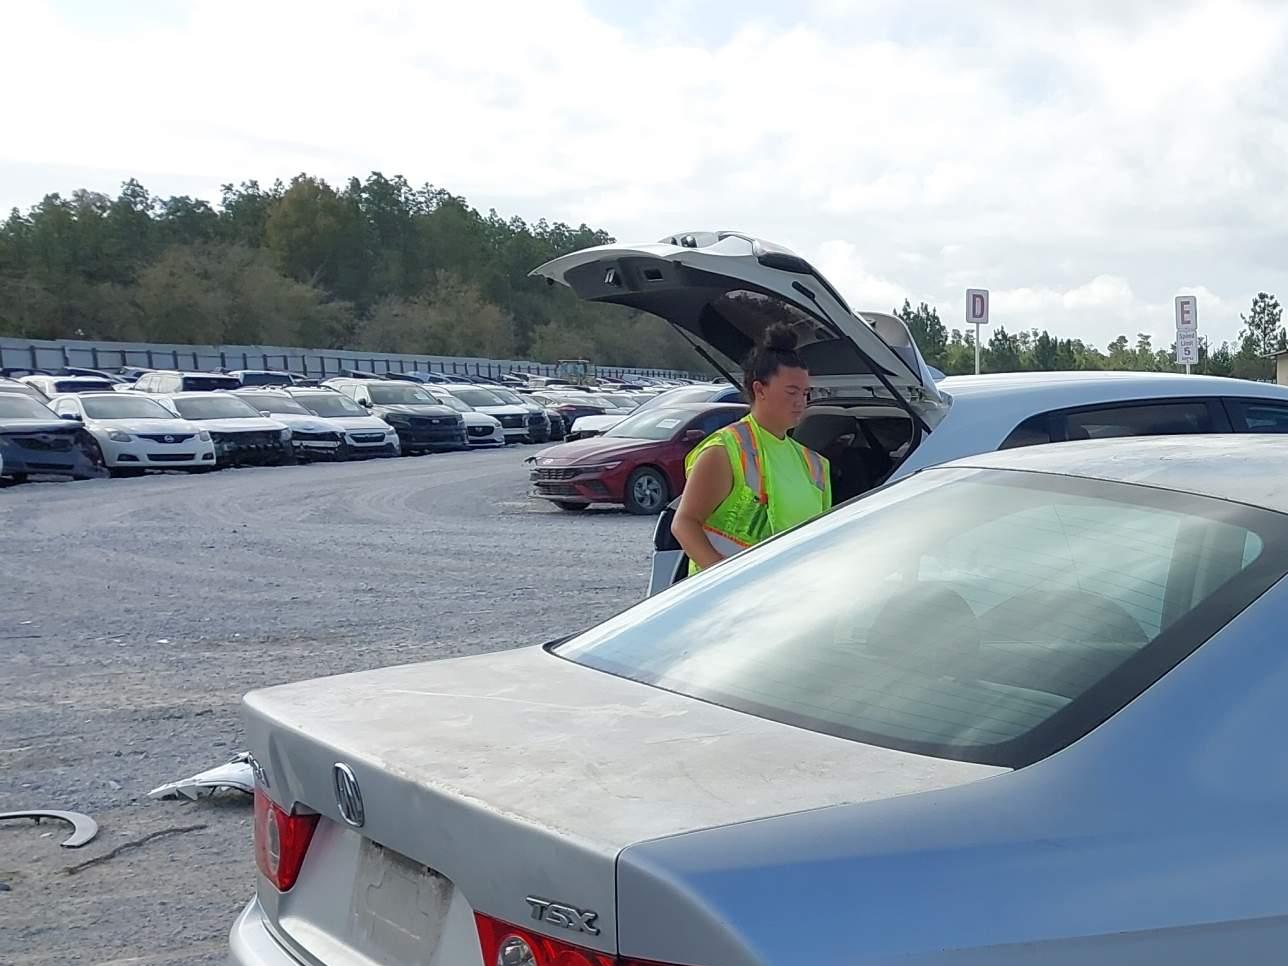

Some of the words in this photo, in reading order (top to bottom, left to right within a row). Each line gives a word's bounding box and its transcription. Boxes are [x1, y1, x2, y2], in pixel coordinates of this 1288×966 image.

[972, 294, 985, 318] D
[1180, 301, 1191, 324] E
[1183, 347, 1191, 356] 5
[525, 896, 601, 936] TSX
